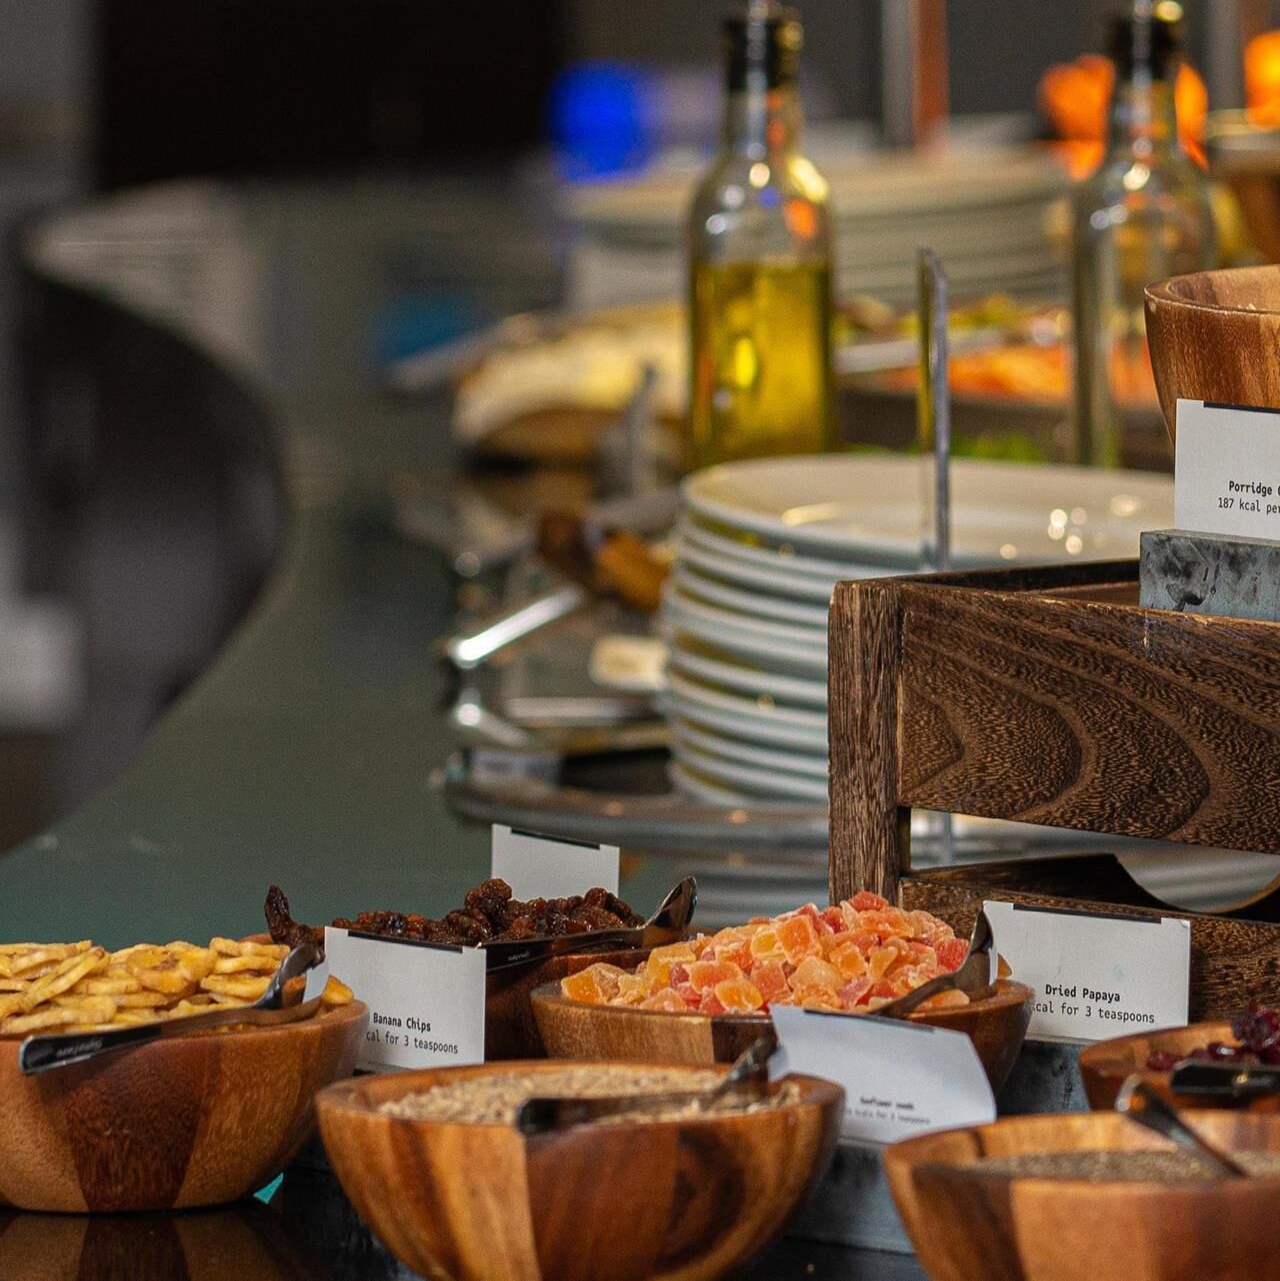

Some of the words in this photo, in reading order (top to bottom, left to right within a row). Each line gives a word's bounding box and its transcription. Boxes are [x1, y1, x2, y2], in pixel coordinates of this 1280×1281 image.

[1228, 480, 1272, 498] Porridge
[1218, 497, 1234, 509] 187
[1239, 499, 1261, 512] kcal
[1045, 984, 1077, 998] Dried
[1082, 987, 1120, 1004] Papaya
[373, 1012, 402, 1027] Banana
[406, 1017, 431, 1034] Chips
[1061, 1002, 1079, 1016] for
[1085, 1005, 1092, 1017] 3
[1098, 1007, 1155, 1024] teaspoons
[366, 1029, 380, 1042] cal
[385, 1031, 399, 1045] for
[404, 1035, 409, 1047] 3
[414, 1037, 458, 1054] teaspoons
